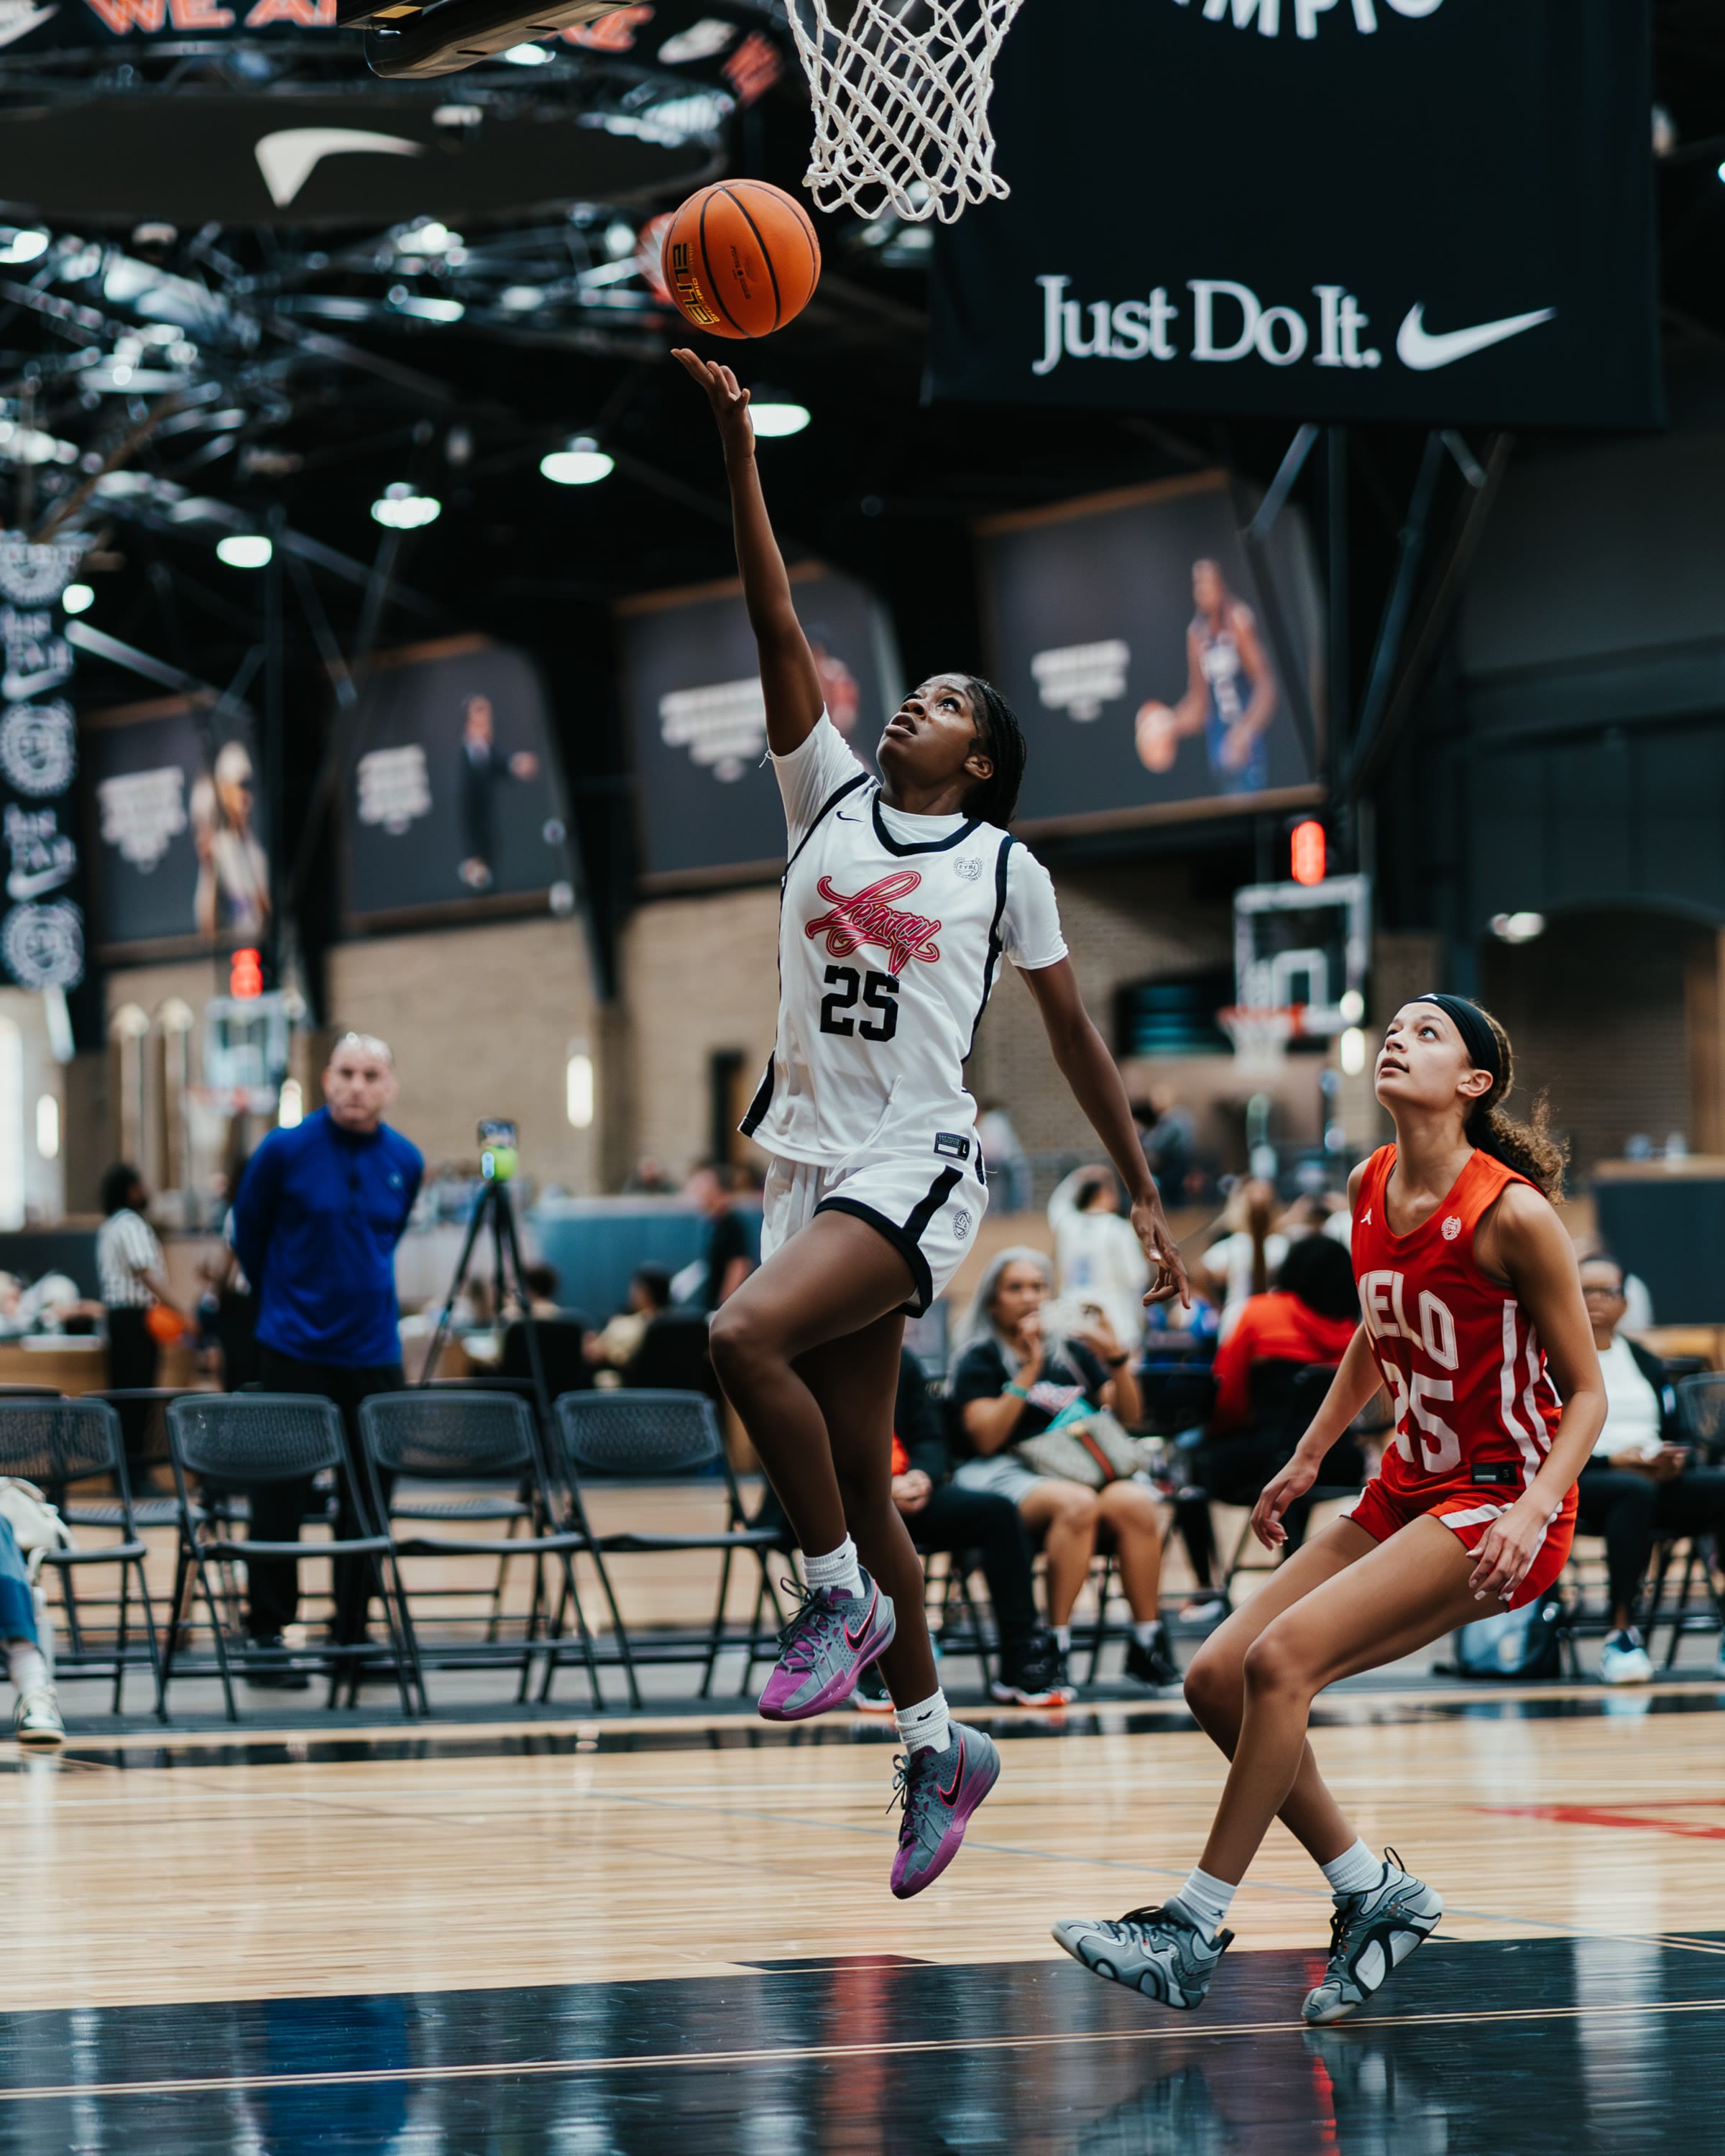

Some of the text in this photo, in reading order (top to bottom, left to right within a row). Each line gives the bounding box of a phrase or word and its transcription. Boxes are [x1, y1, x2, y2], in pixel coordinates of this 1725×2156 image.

[673, 243, 714, 324] ELITE
[1032, 275, 1381, 375] Just Do It.
[805, 870, 942, 977] Legacy
[820, 964, 900, 1042] 25
[962, 1143, 967, 1154] L
